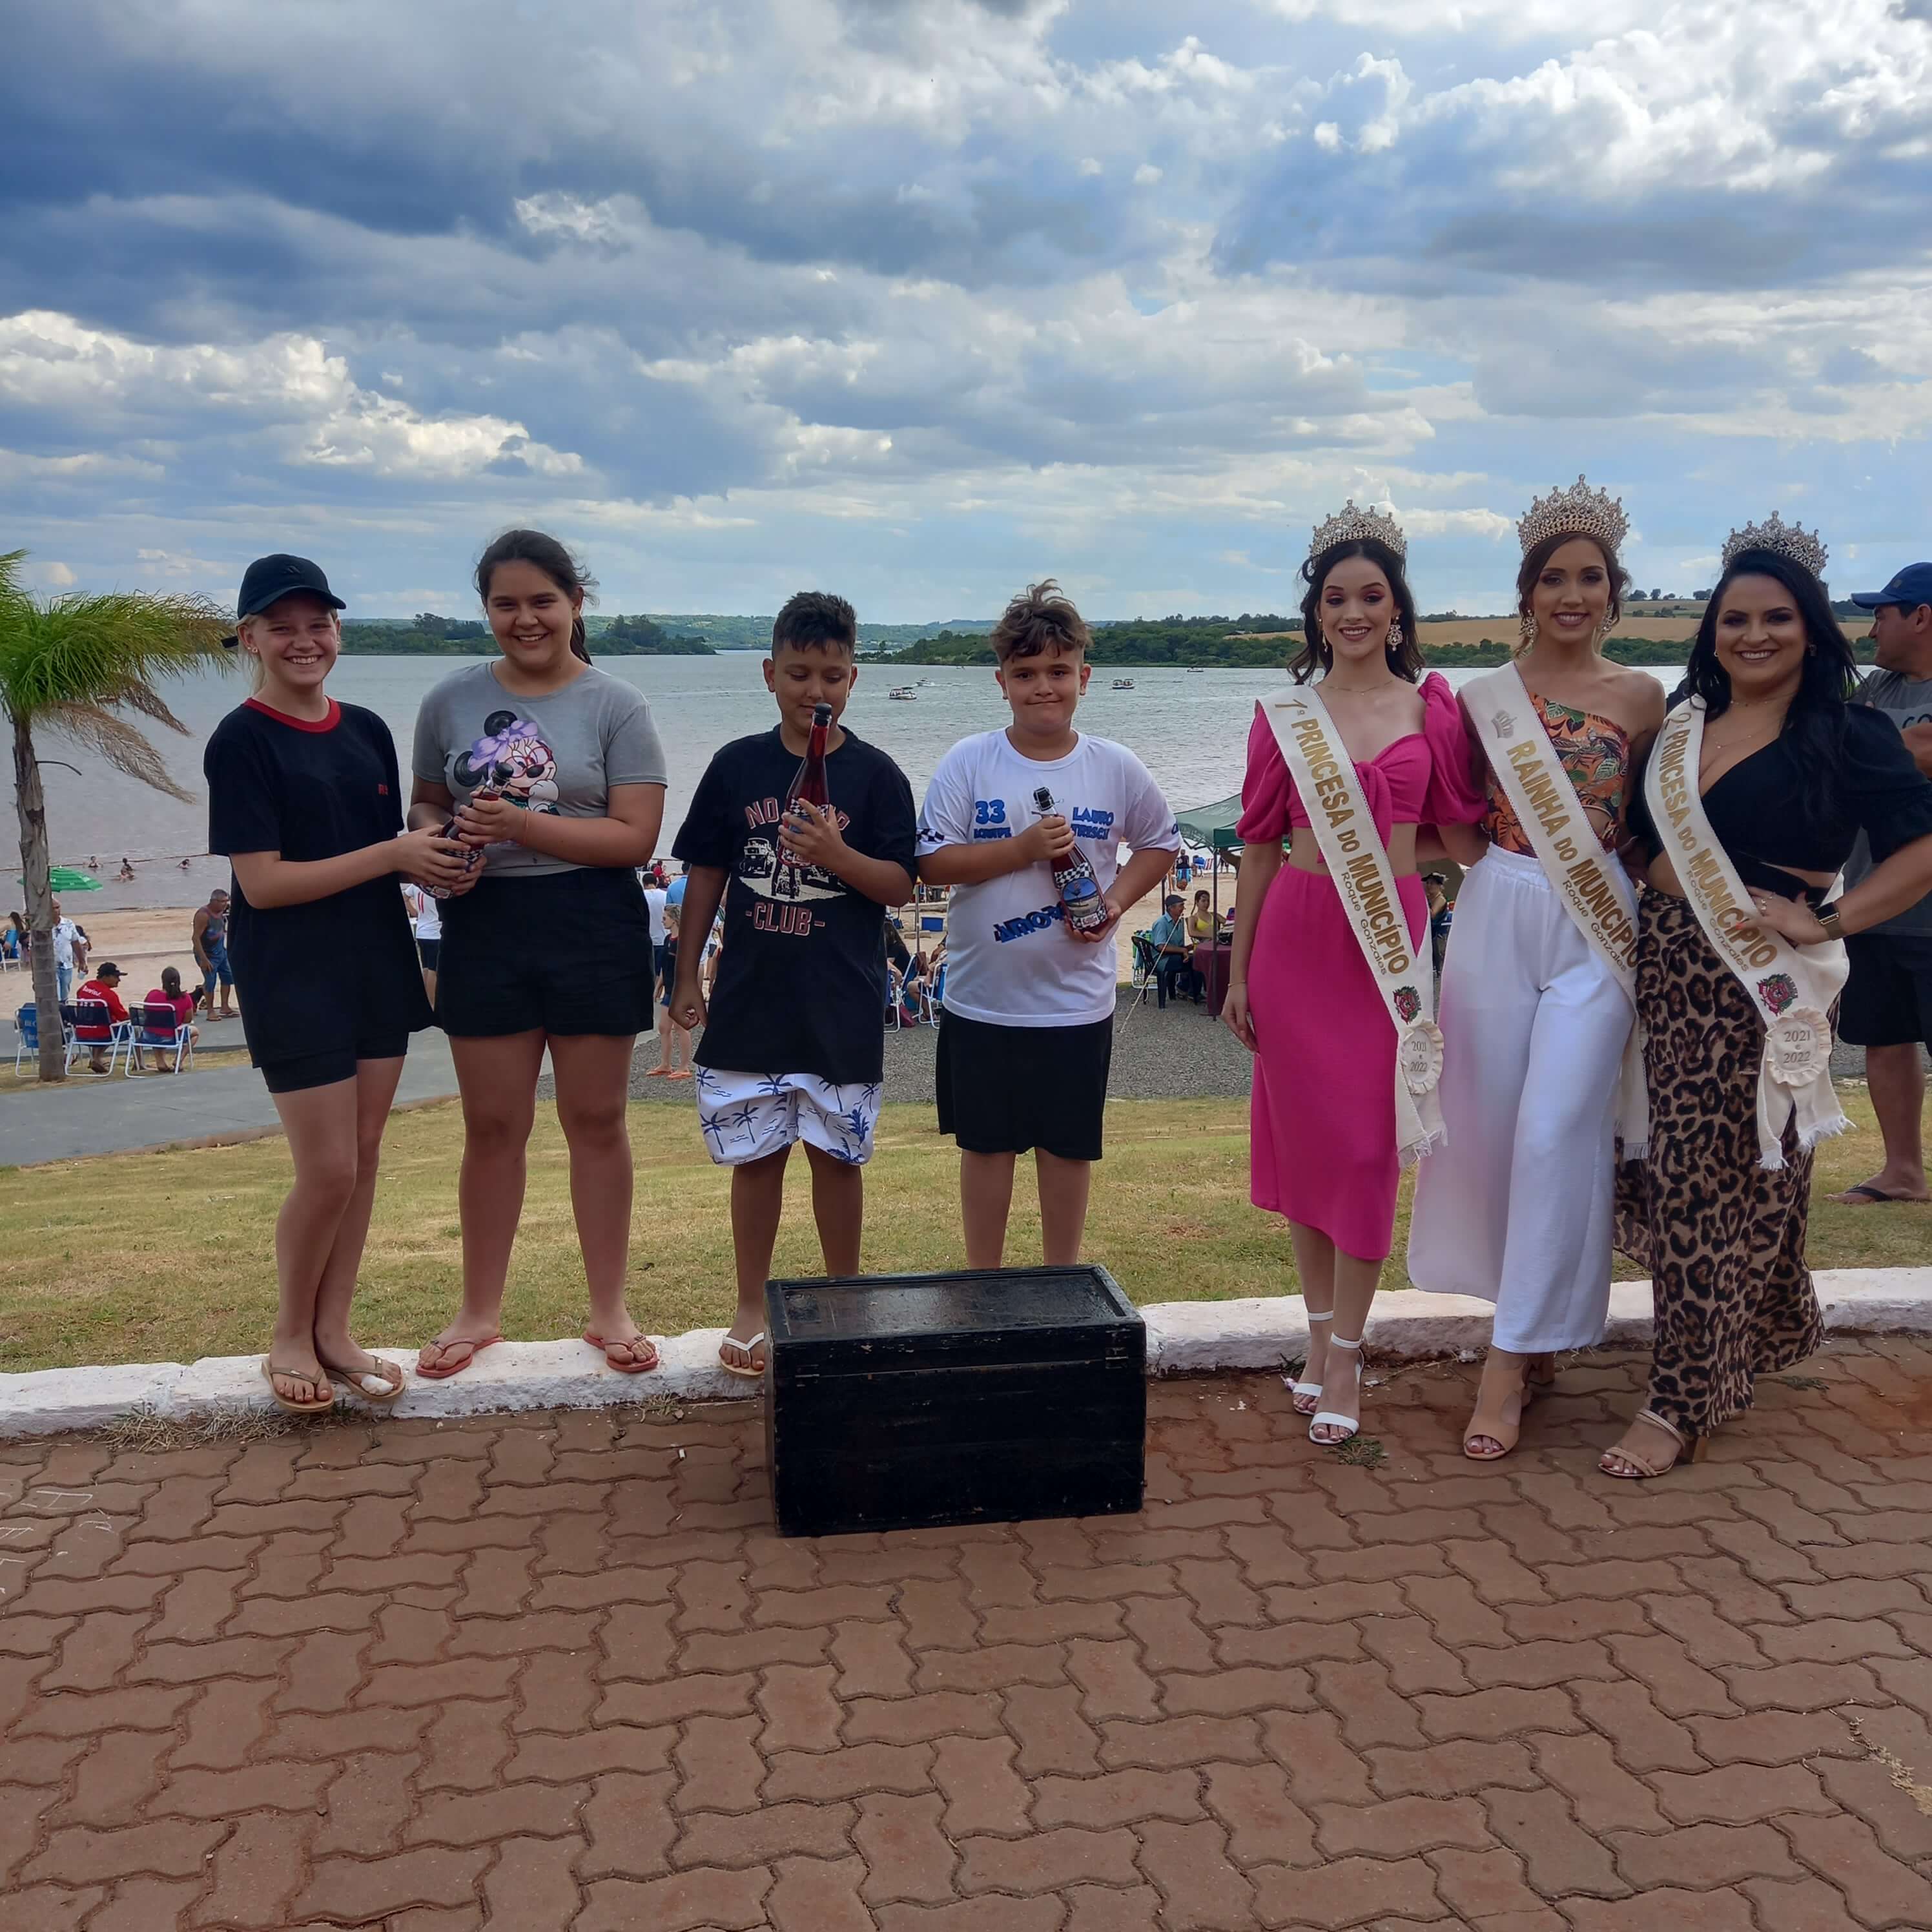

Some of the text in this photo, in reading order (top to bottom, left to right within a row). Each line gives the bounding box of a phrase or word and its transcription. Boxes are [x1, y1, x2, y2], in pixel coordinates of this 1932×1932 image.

[975, 799, 1006, 825] 33
[1291, 718, 1355, 829] PRINCESA
[1337, 829, 1361, 852] DO
[1506, 739, 1639, 968] RAINHA DO MUNICÍPIO
[1658, 729, 1690, 828] PRINCESA
[1678, 826, 1698, 852] DO
[1689, 848, 1778, 967] MUNICÍPIO
[1341, 872, 1387, 976] Roque Gonzales
[1346, 852, 1410, 975] MUNICÍPIO
[1563, 880, 1627, 971] Roque Gonzales
[1686, 870, 1749, 971] Roque Gonzales
[1410, 1061, 1428, 1073] 2022
[1411, 1041, 1426, 1052] 2021
[1783, 1030, 1810, 1042] 2021
[1783, 1051, 1811, 1064] 2022
